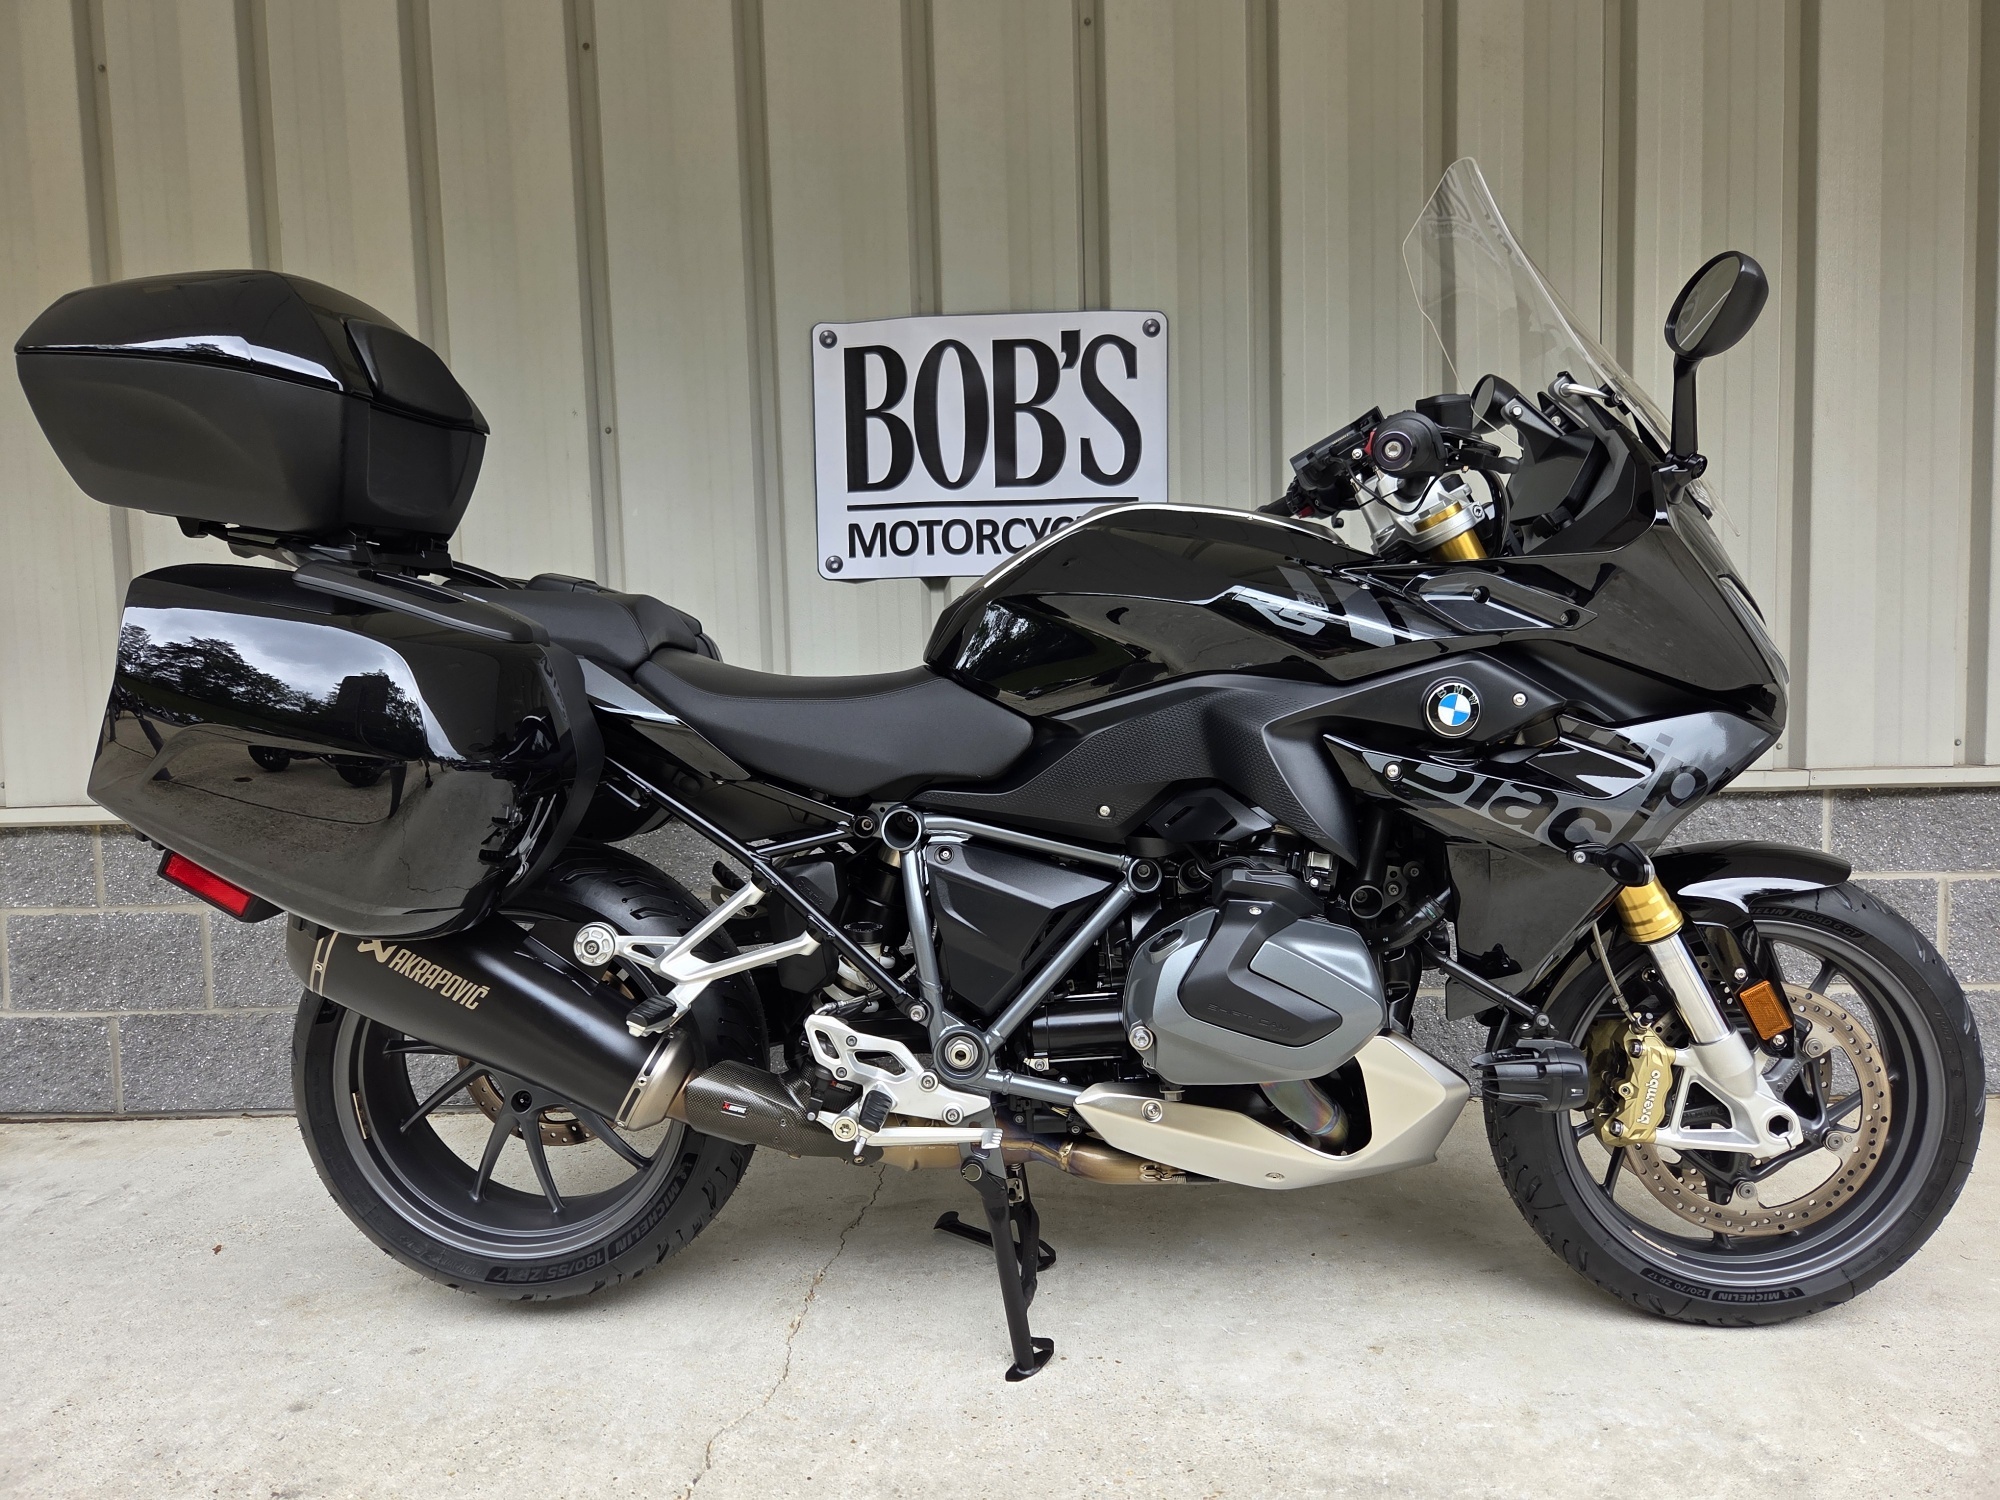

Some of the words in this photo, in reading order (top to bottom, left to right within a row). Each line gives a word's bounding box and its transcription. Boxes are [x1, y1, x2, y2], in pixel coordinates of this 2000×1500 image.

[843, 329, 1143, 492] BOB'S
[848, 517, 1084, 558] MOTORCY
[1436, 684, 1479, 705] BMW
[1386, 754, 1650, 850] lac
[1797, 912, 1833, 926] ROAD
[1636, 1069, 1661, 1124] brembo
[614, 1182, 684, 1254] MICHELIN
[547, 1246, 606, 1279] 180/55
[1674, 1282, 1707, 1297] 120/70
[1717, 1291, 1781, 1302] MICHELIN
